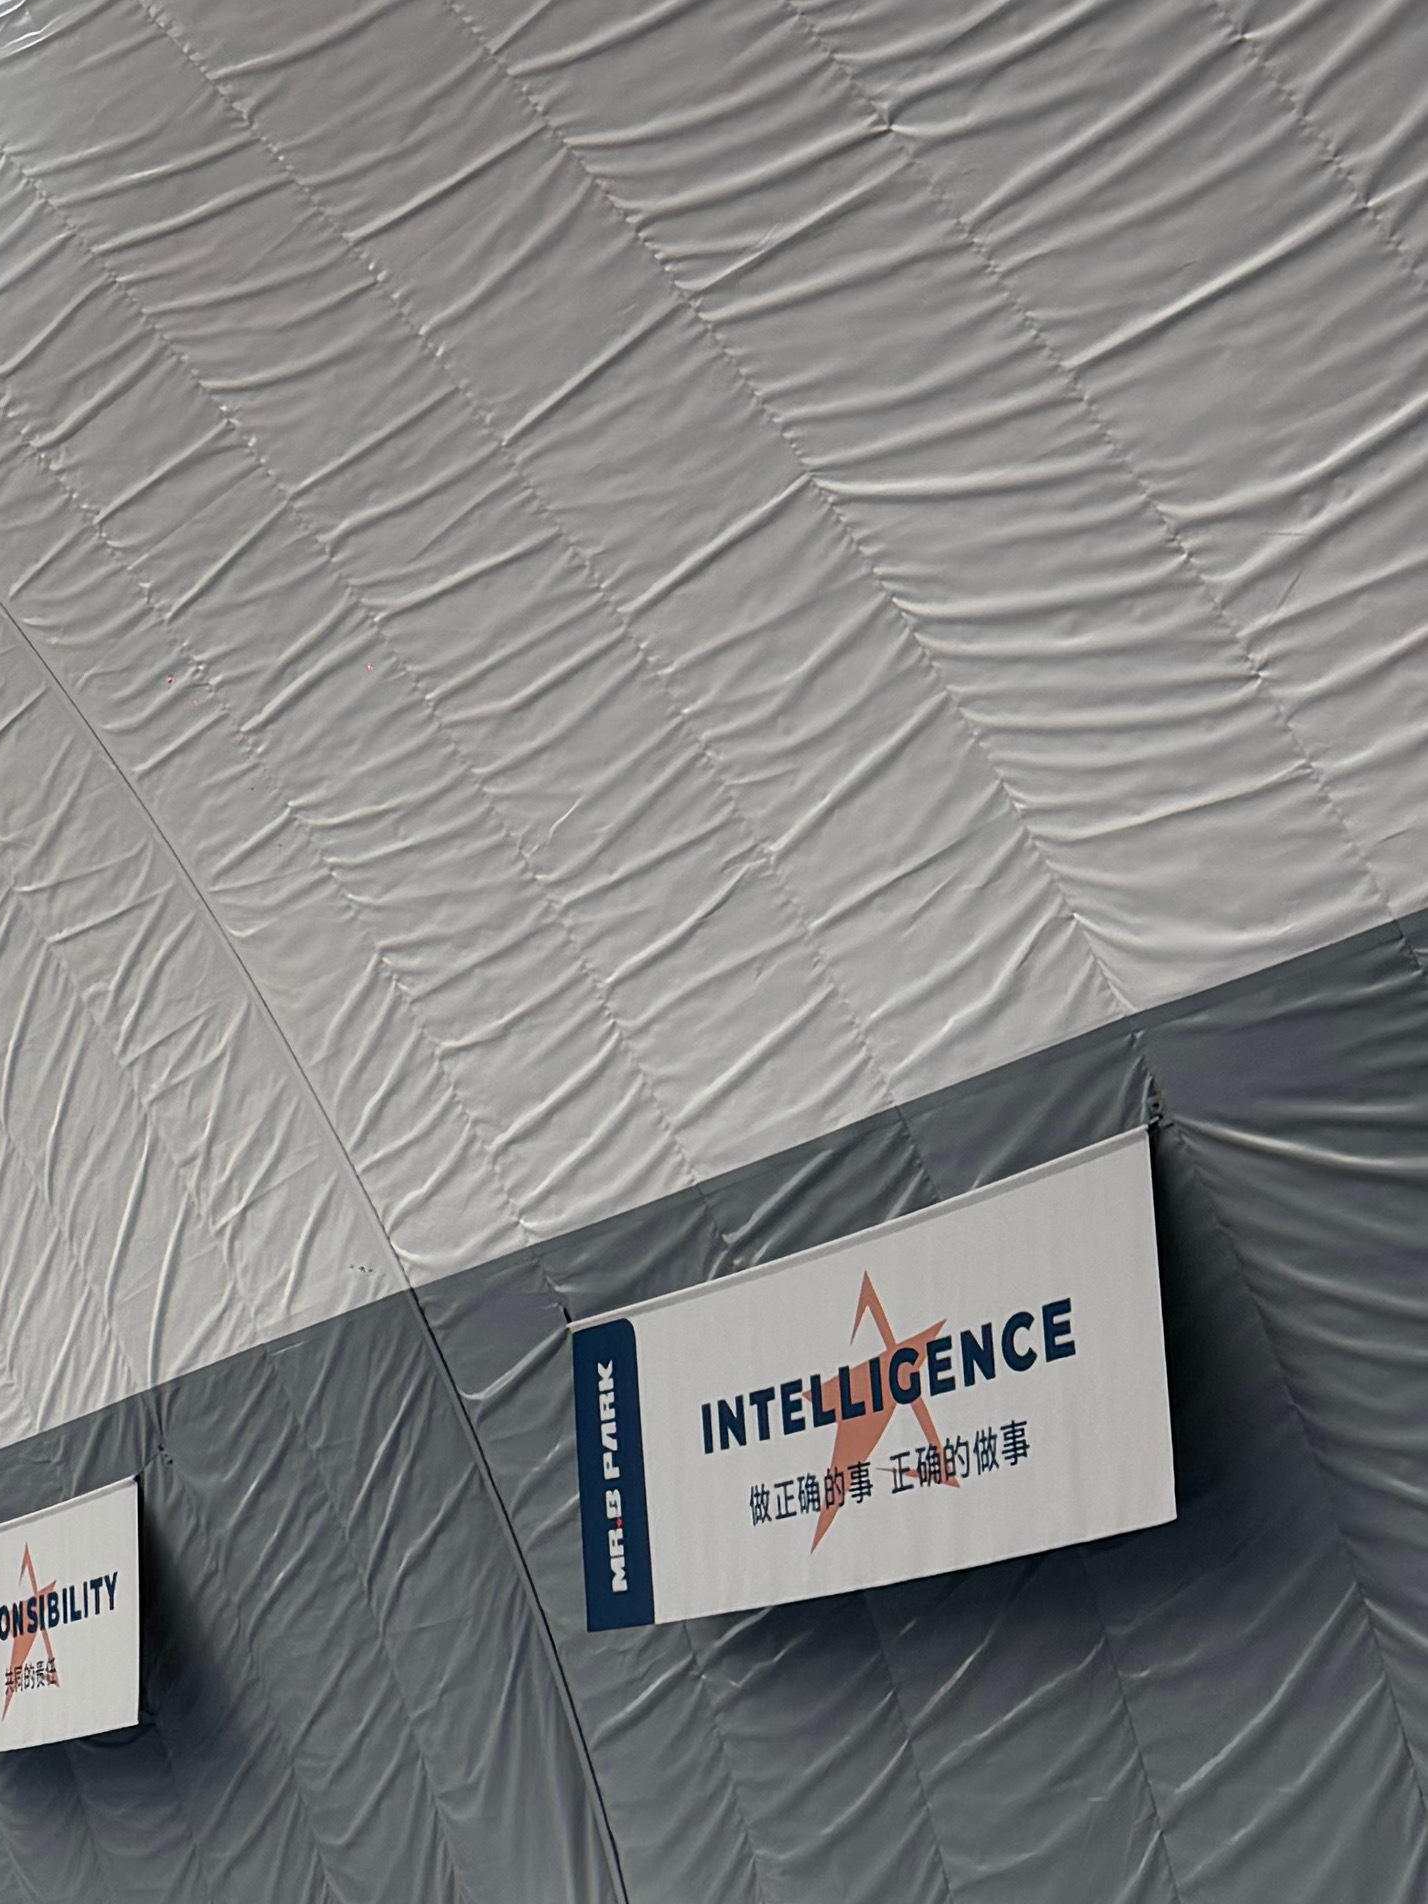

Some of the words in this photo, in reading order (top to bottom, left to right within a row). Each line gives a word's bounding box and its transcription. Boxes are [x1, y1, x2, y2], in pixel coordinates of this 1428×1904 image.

[597, 1359, 621, 1480] PARK
[701, 1297, 1076, 1454] INTELLIGENCE
[749, 1460, 874, 1526] 做正确的事
[889, 1419, 1030, 1494] 正确的做事
[5, 1657, 57, 1696] 共同的责任
